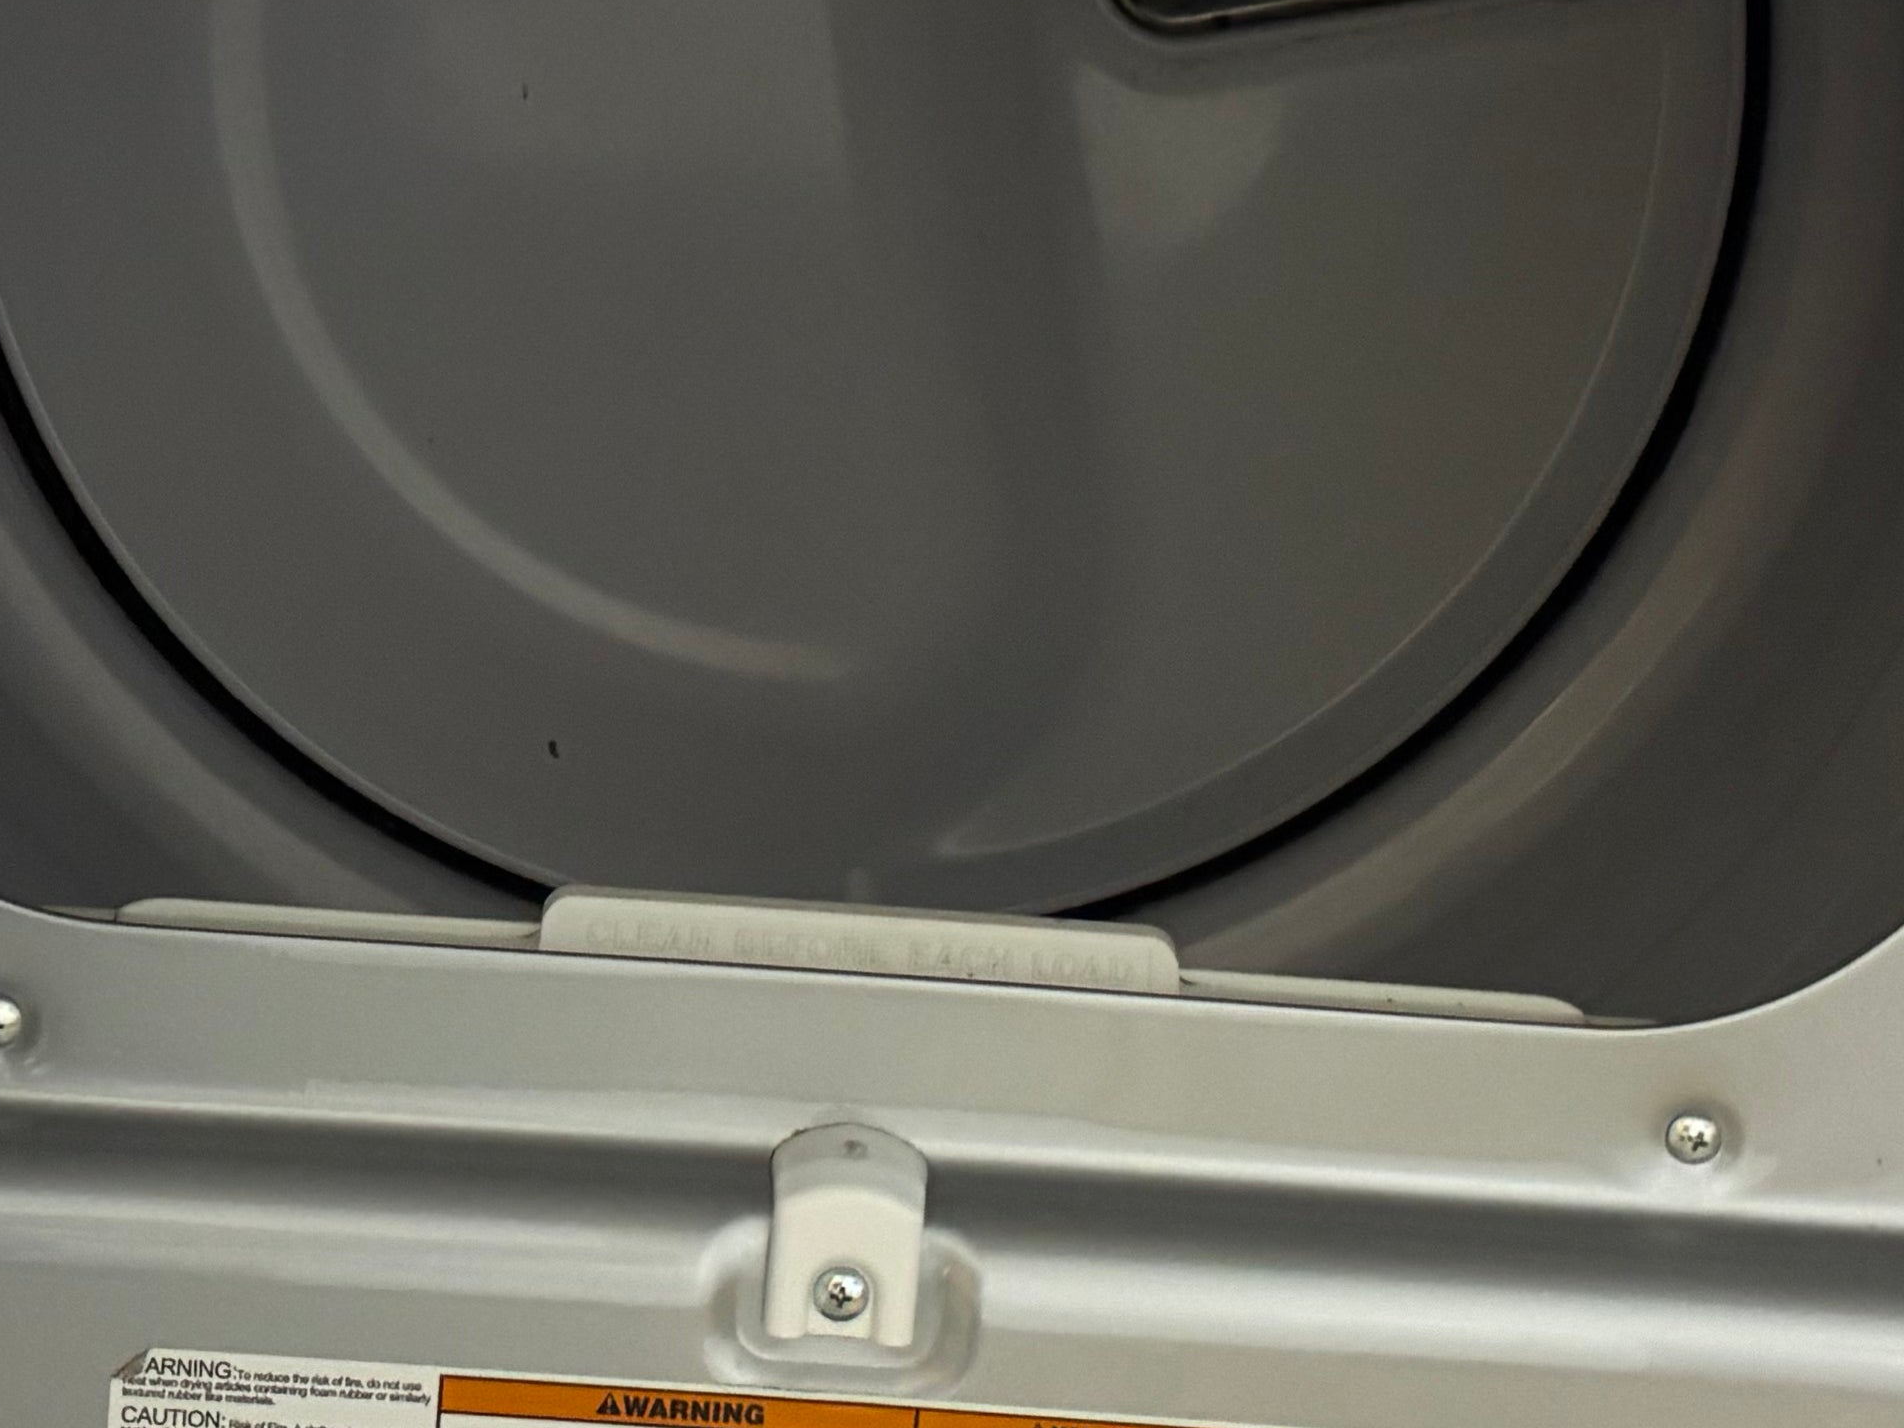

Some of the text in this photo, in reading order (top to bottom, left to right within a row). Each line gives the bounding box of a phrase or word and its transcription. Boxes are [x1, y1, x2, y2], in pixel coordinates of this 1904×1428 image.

[144, 1354, 237, 1380] ARNING:
[121, 1405, 226, 1428] CAUTION:
[623, 1395, 764, 1425] WARNING
